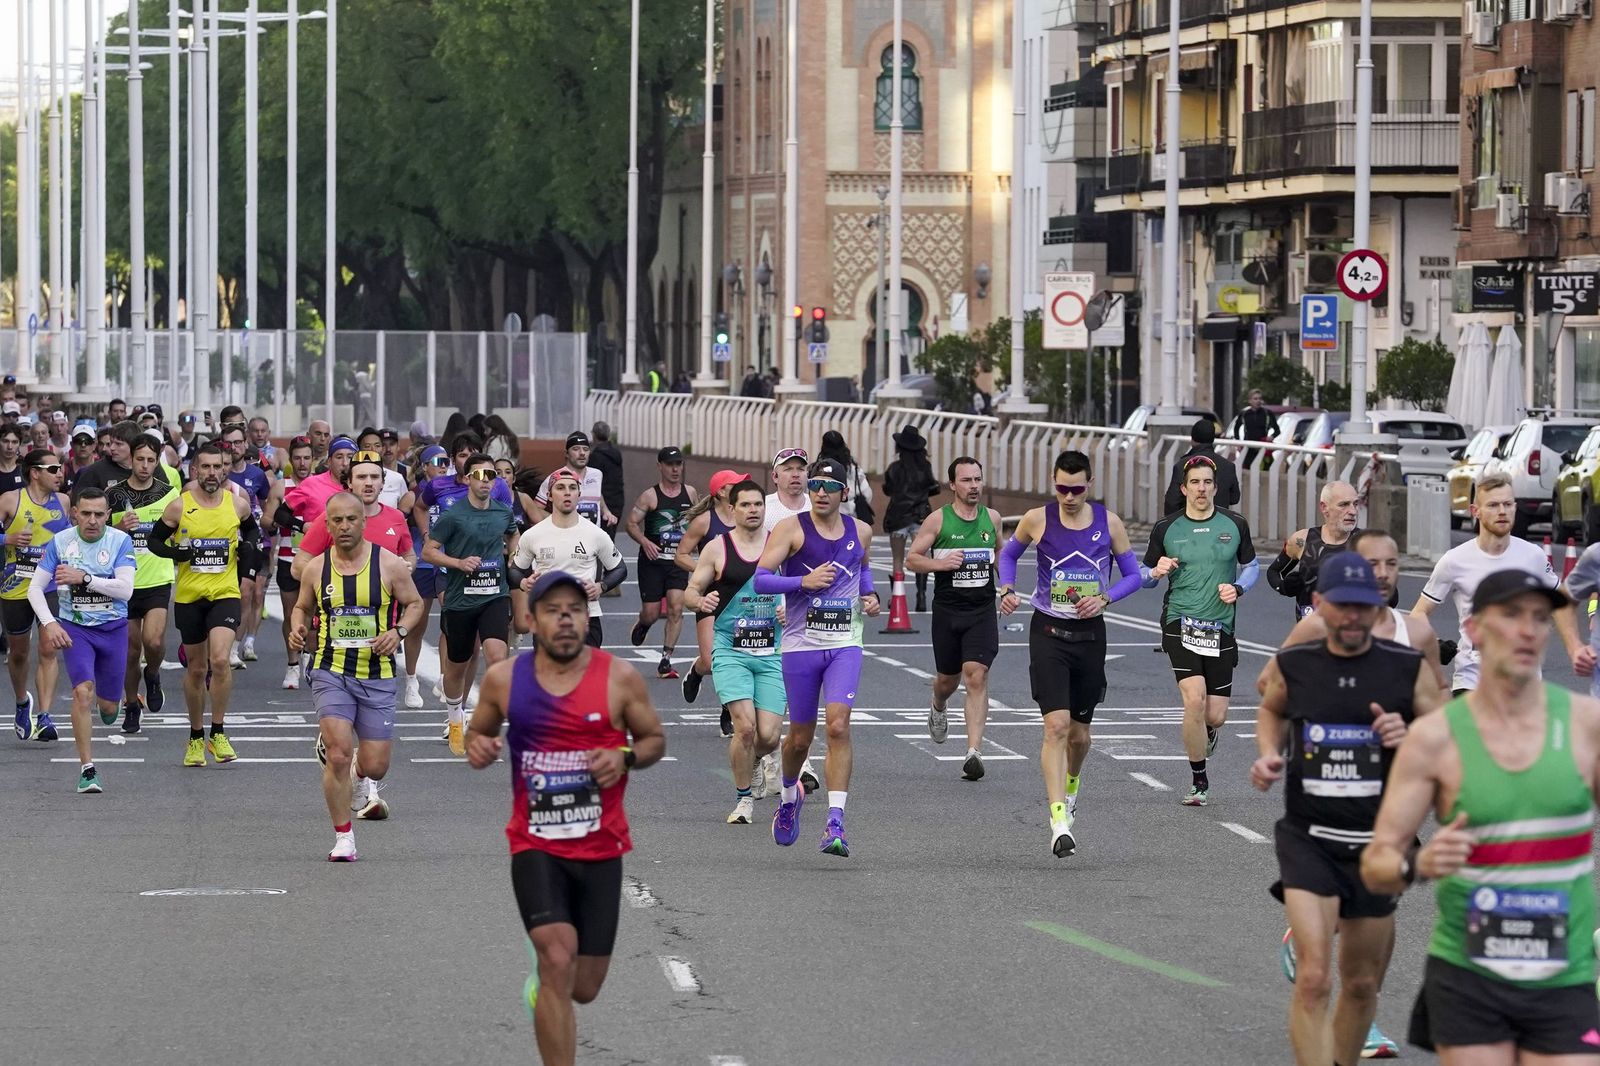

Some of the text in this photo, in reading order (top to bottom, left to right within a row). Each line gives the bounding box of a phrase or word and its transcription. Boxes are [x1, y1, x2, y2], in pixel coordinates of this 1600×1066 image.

[1047, 275, 1091, 284] CARRIL BUS
[1537, 275, 1595, 289] TINTE
[1306, 299, 1328, 328] P
[965, 552, 987, 560] ZURICH
[195, 557, 225, 566] SAMUEL
[952, 569, 991, 580] JOSE SILVA
[1067, 573, 1095, 581] ZURICH
[471, 577, 497, 587] RAMÓN
[72, 596, 91, 604] JESUS
[824, 599, 849, 607] ZURICH
[345, 607, 370, 615] ZURICH
[824, 612, 838, 620] 5337
[806, 621, 852, 632] LAMILLA.RUN
[338, 628, 368, 638] SABAN
[740, 638, 768, 648] OLIVER
[1182, 634, 1218, 647] REDONDO
[1327, 728, 1373, 740] ZURICH
[1320, 763, 1362, 779] RAUL
[550, 774, 592, 786] ZURICH
[529, 805, 603, 825] JUAN DAVID
[1501, 893, 1560, 907] ZURICH
[1483, 936, 1550, 959] SIMON
